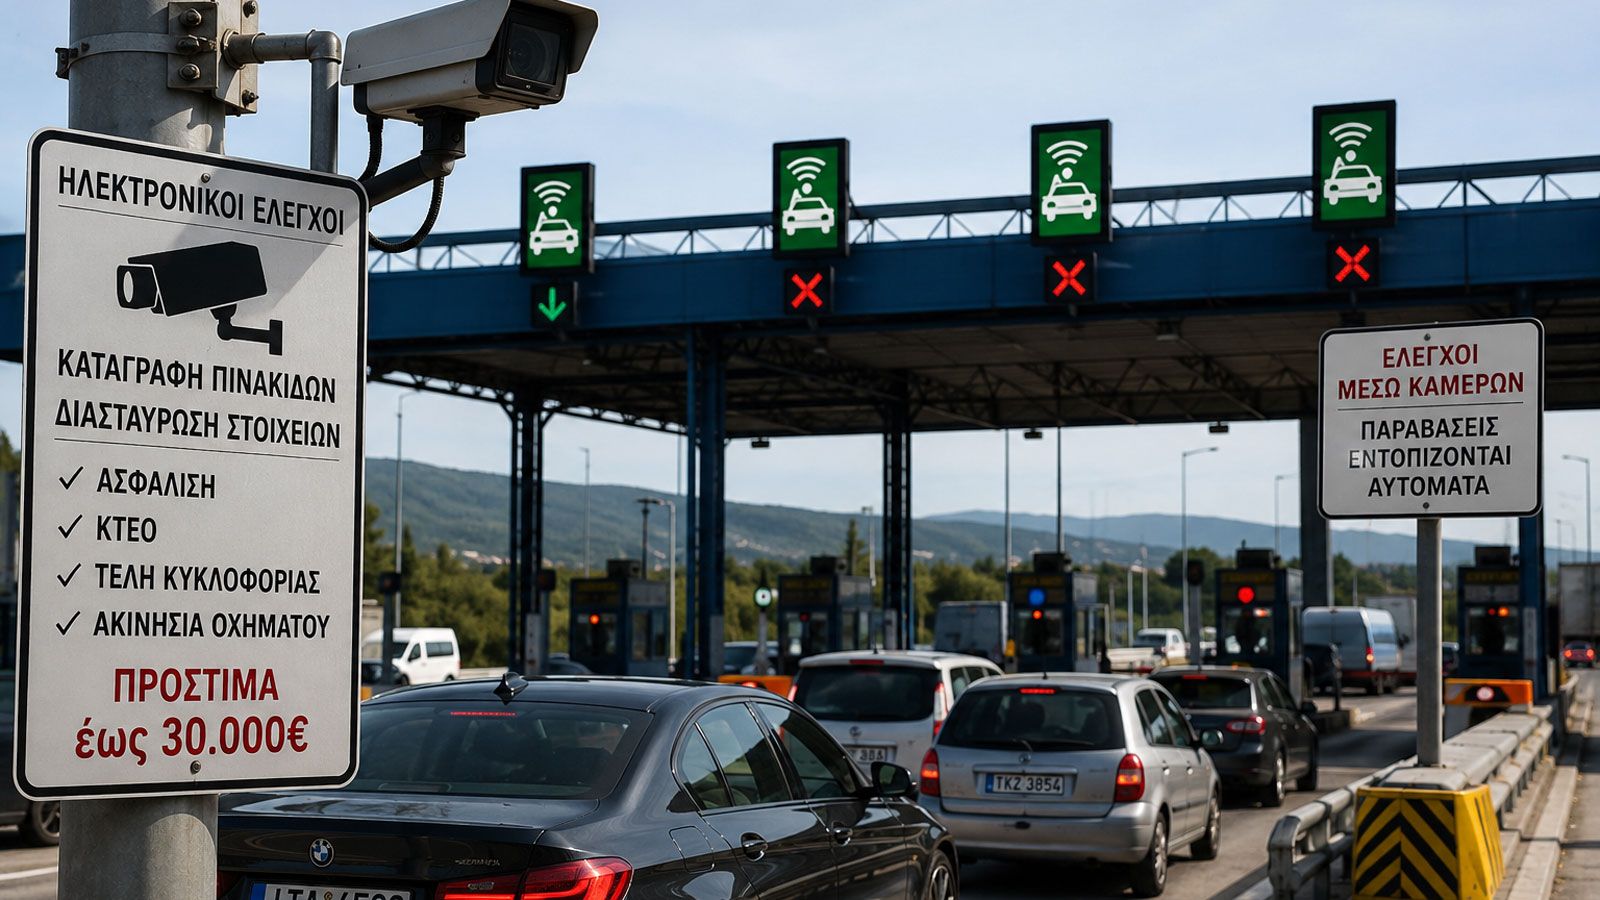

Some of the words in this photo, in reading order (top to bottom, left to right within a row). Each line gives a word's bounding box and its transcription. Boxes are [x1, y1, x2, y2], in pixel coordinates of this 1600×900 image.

[58, 167, 244, 220] ΗΛΕΚΤΡΟΝΙΚΟΙ
[254, 196, 343, 235] ΕΛΕΓΧΟΙ
[1383, 344, 1477, 369] ΕΛΕΓΧΟΙ
[59, 349, 202, 389] ΚΑΤΑΓΡΑΦΗ
[213, 366, 335, 403] ΠΙΝΑΚΙΔΩΝ
[1339, 378, 1400, 399] ΜΕΣΩ
[1410, 372, 1523, 396] ΚΑΜΕΡΩΝ
[55, 399, 218, 438] ΔΙΑΣΤΑΥΡΩΣΗ
[228, 414, 339, 448] ΣΤΟΙΧΕΙΩΝ
[1362, 417, 1498, 440] ΠΑΡΑΒΑΣΕΙΣ
[1350, 445, 1510, 468] ΕΝΤΟΠΙΖΟΝΤΑΙ
[97, 468, 215, 498] ΑΣΦΑΛΙΣΗ
[1368, 475, 1489, 496] ΑΥΤΟΜΑΤΑ
[97, 516, 156, 542] ΚΤΕΟ
[95, 563, 154, 589] ΤΕΛΗ
[164, 566, 320, 594] ΚΥΚΛΟΦΟΡΙΑΣ
[93, 611, 204, 637] ΑΚΙΝΗΣΙΑ
[212, 613, 330, 638] ΟΧΗΜΑΤΟΥ
[115, 668, 278, 702] ΠΡΟΣΤΙΜΑ
[76, 718, 148, 765] έως
[162, 716, 308, 756] 30.000€
[1026, 777, 1061, 791] 3854
